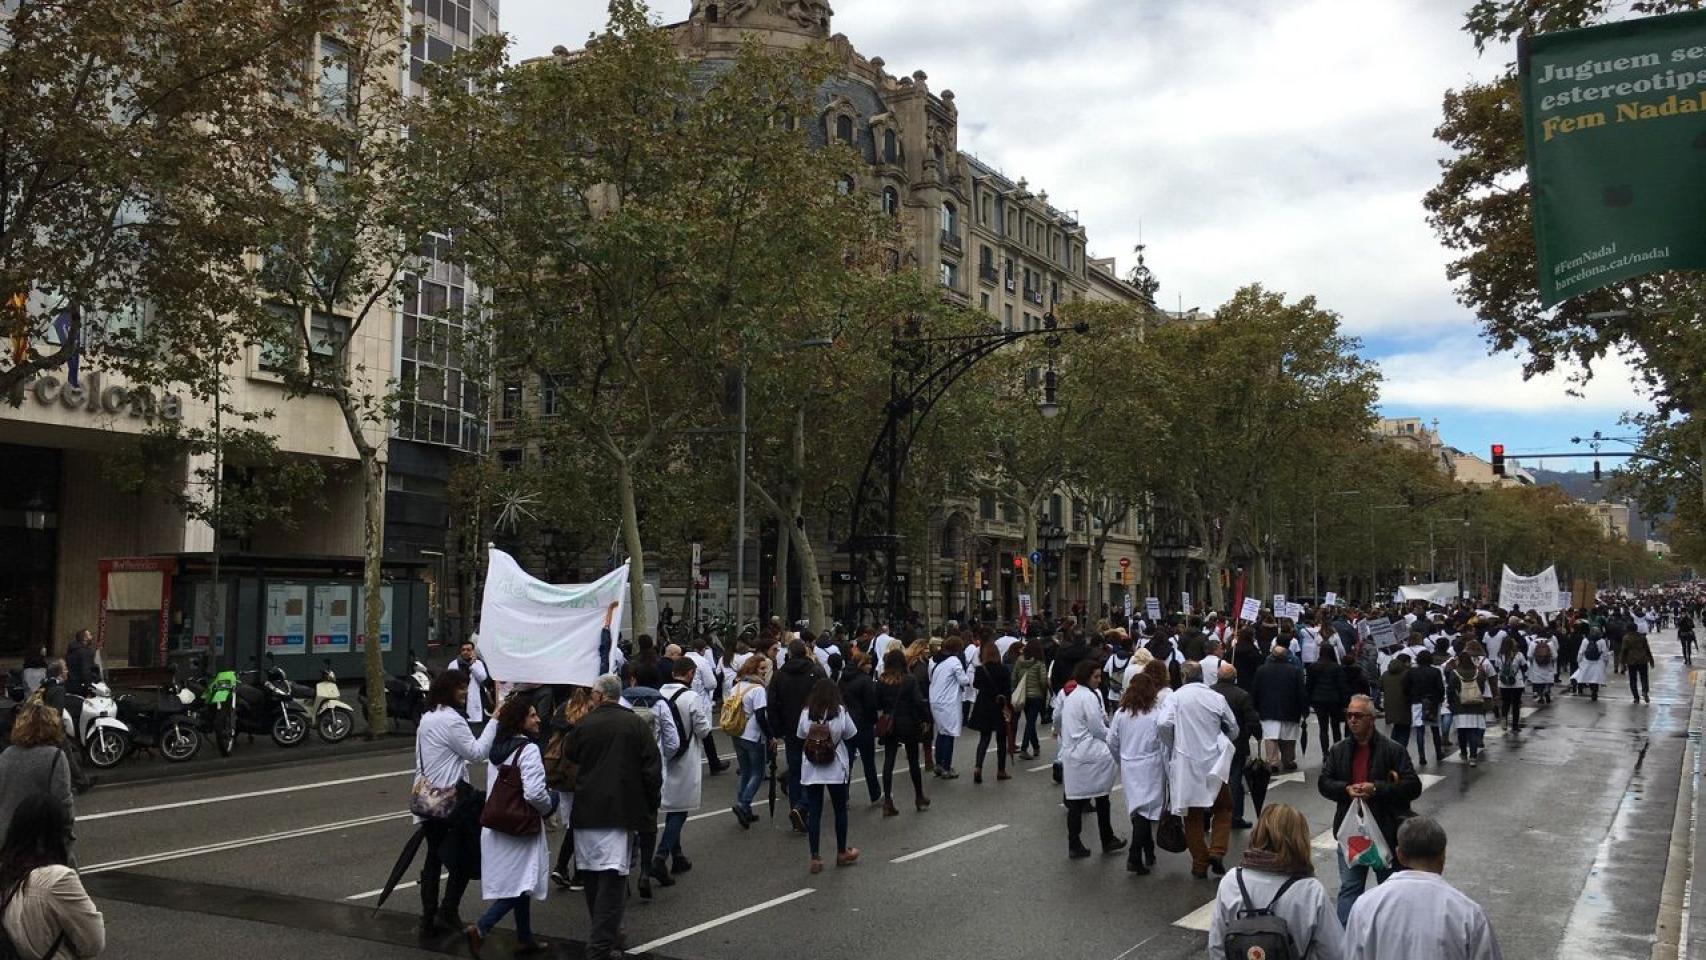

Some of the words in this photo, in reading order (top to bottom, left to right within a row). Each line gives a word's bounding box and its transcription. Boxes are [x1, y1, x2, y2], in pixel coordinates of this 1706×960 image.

[1538, 53, 1661, 83] Juguem
[1541, 69, 1706, 110] estereotips
[1542, 112, 1606, 141] Fem
[1616, 90, 1706, 122] Nadal
[1554, 242, 1617, 275] #FemNadal
[1555, 246, 1670, 290] barcelona.cat/nadal
[25, 371, 182, 421] celona
